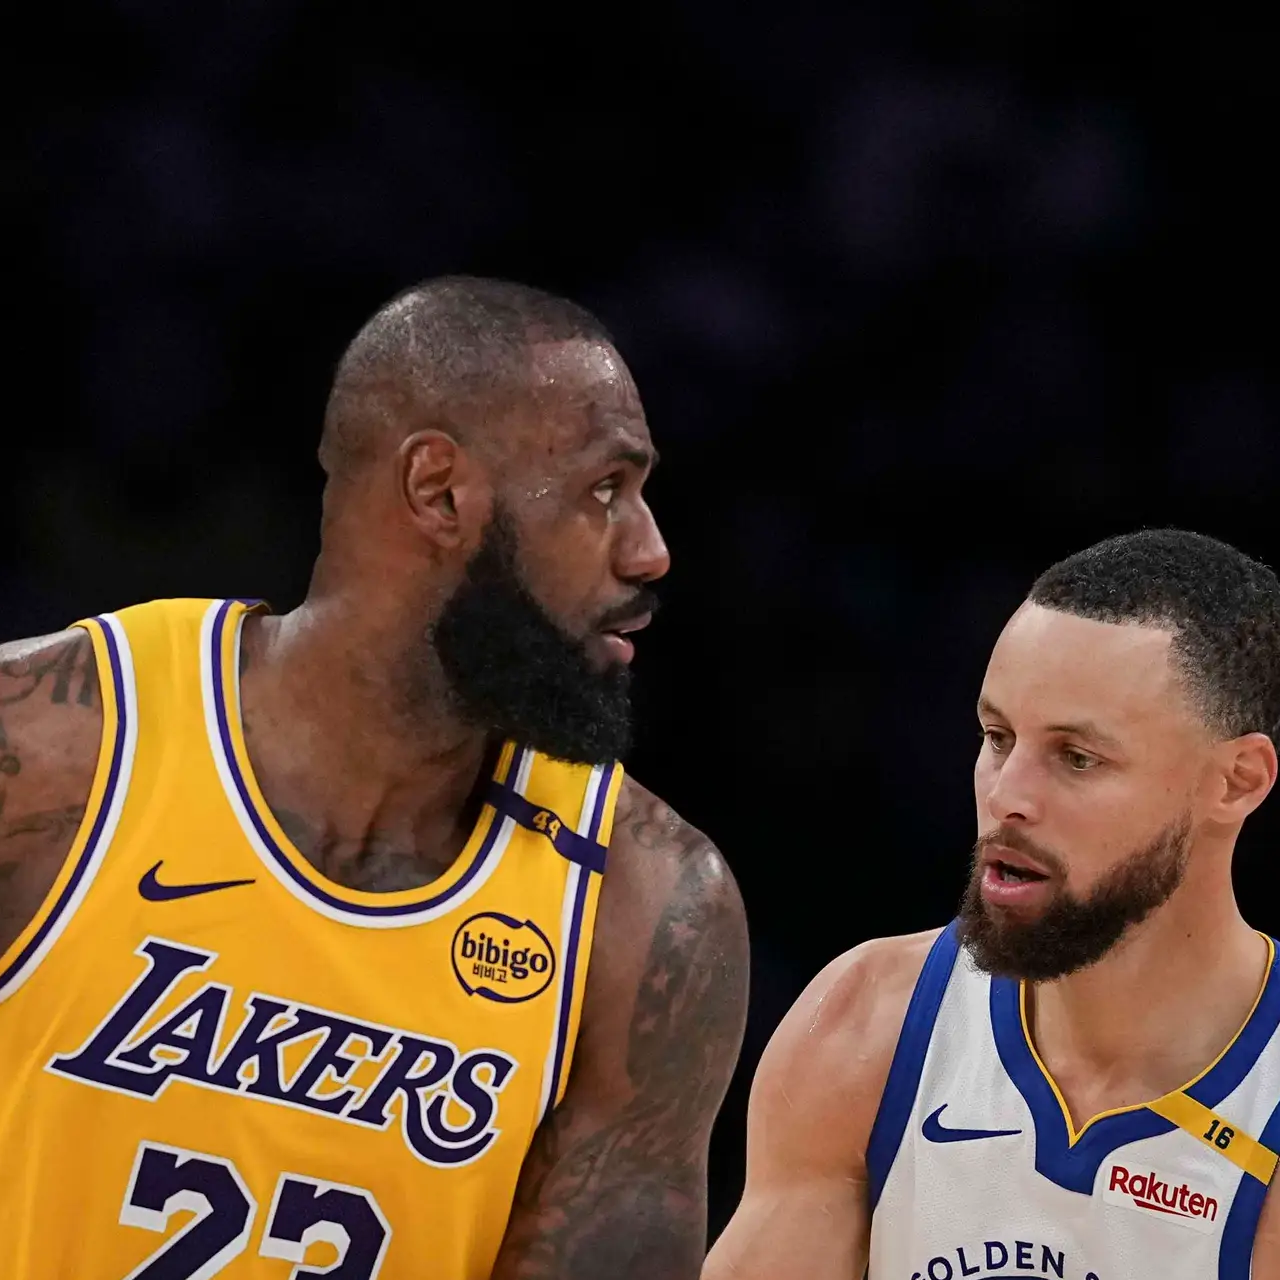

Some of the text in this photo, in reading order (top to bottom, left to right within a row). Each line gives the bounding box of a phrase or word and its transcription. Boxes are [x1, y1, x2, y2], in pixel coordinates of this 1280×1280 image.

[461, 930, 548, 980] bibigo
[472, 962, 508, 984] 비비고
[44, 935, 518, 1168] LAKERS
[1203, 1119, 1235, 1150] 16
[1108, 1165, 1218, 1222] Rakuten
